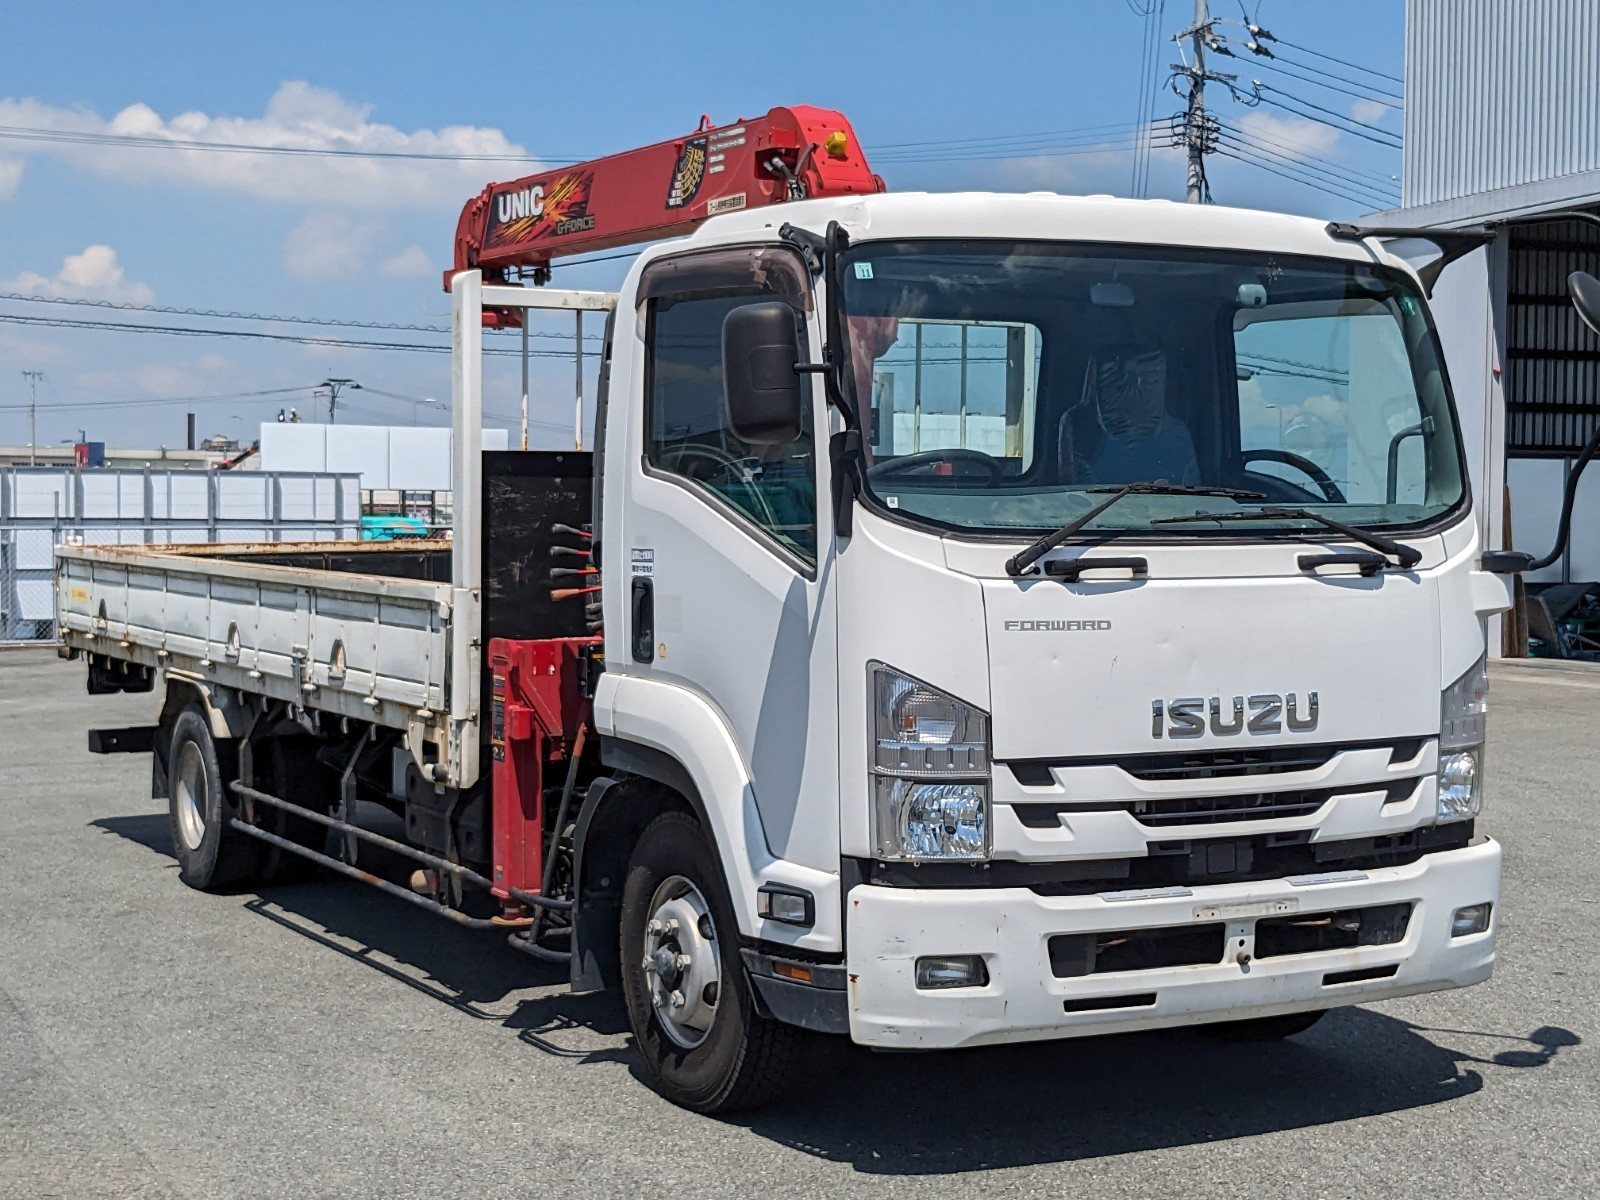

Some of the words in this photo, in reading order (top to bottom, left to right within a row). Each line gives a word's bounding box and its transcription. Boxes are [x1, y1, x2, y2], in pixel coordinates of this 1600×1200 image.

[498, 186, 544, 223] UNIC
[861, 268, 871, 277] 11
[1004, 620, 1112, 631] FORWARD
[1151, 691, 1318, 739] ISUZU
